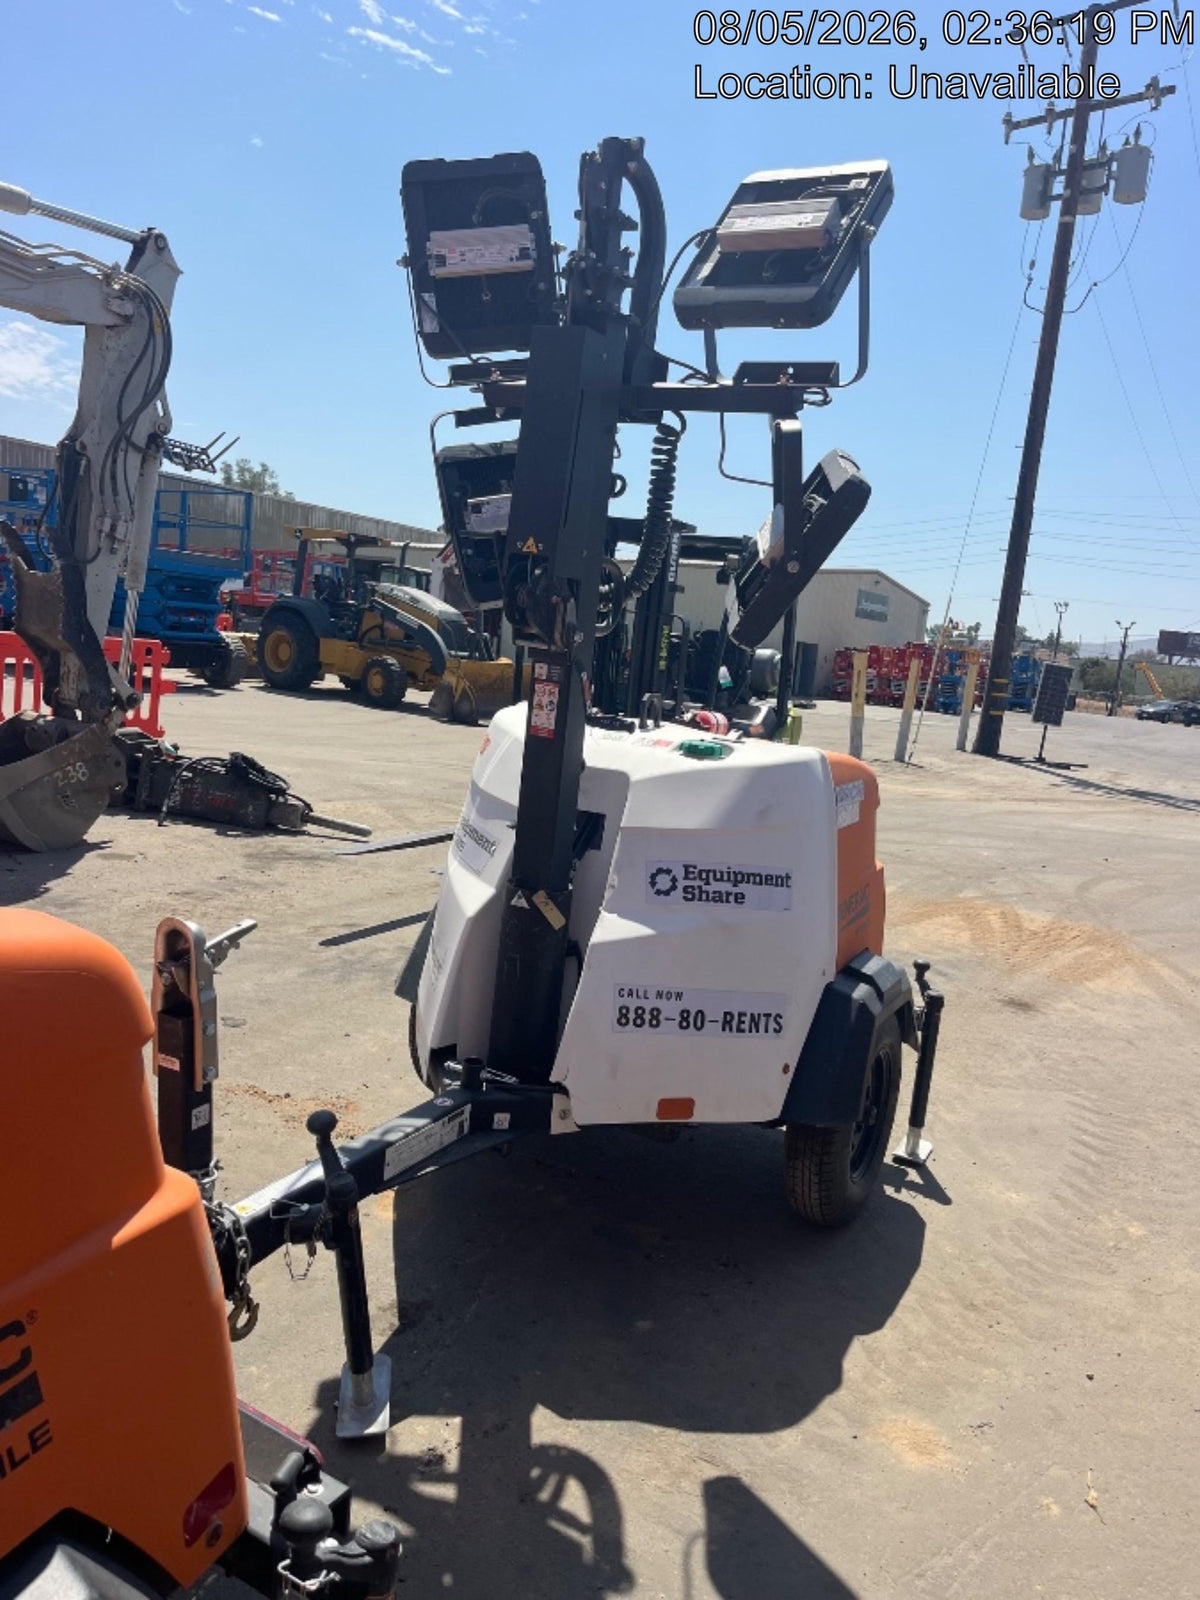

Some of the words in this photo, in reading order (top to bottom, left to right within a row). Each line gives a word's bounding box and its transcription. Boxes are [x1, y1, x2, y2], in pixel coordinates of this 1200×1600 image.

[682, 864, 792, 888] Equipment
[682, 885, 746, 905] Share
[618, 988, 650, 1000] CALL
[656, 990, 684, 1001] NOW
[616, 1005, 783, 1034] 888-80-RENTS
